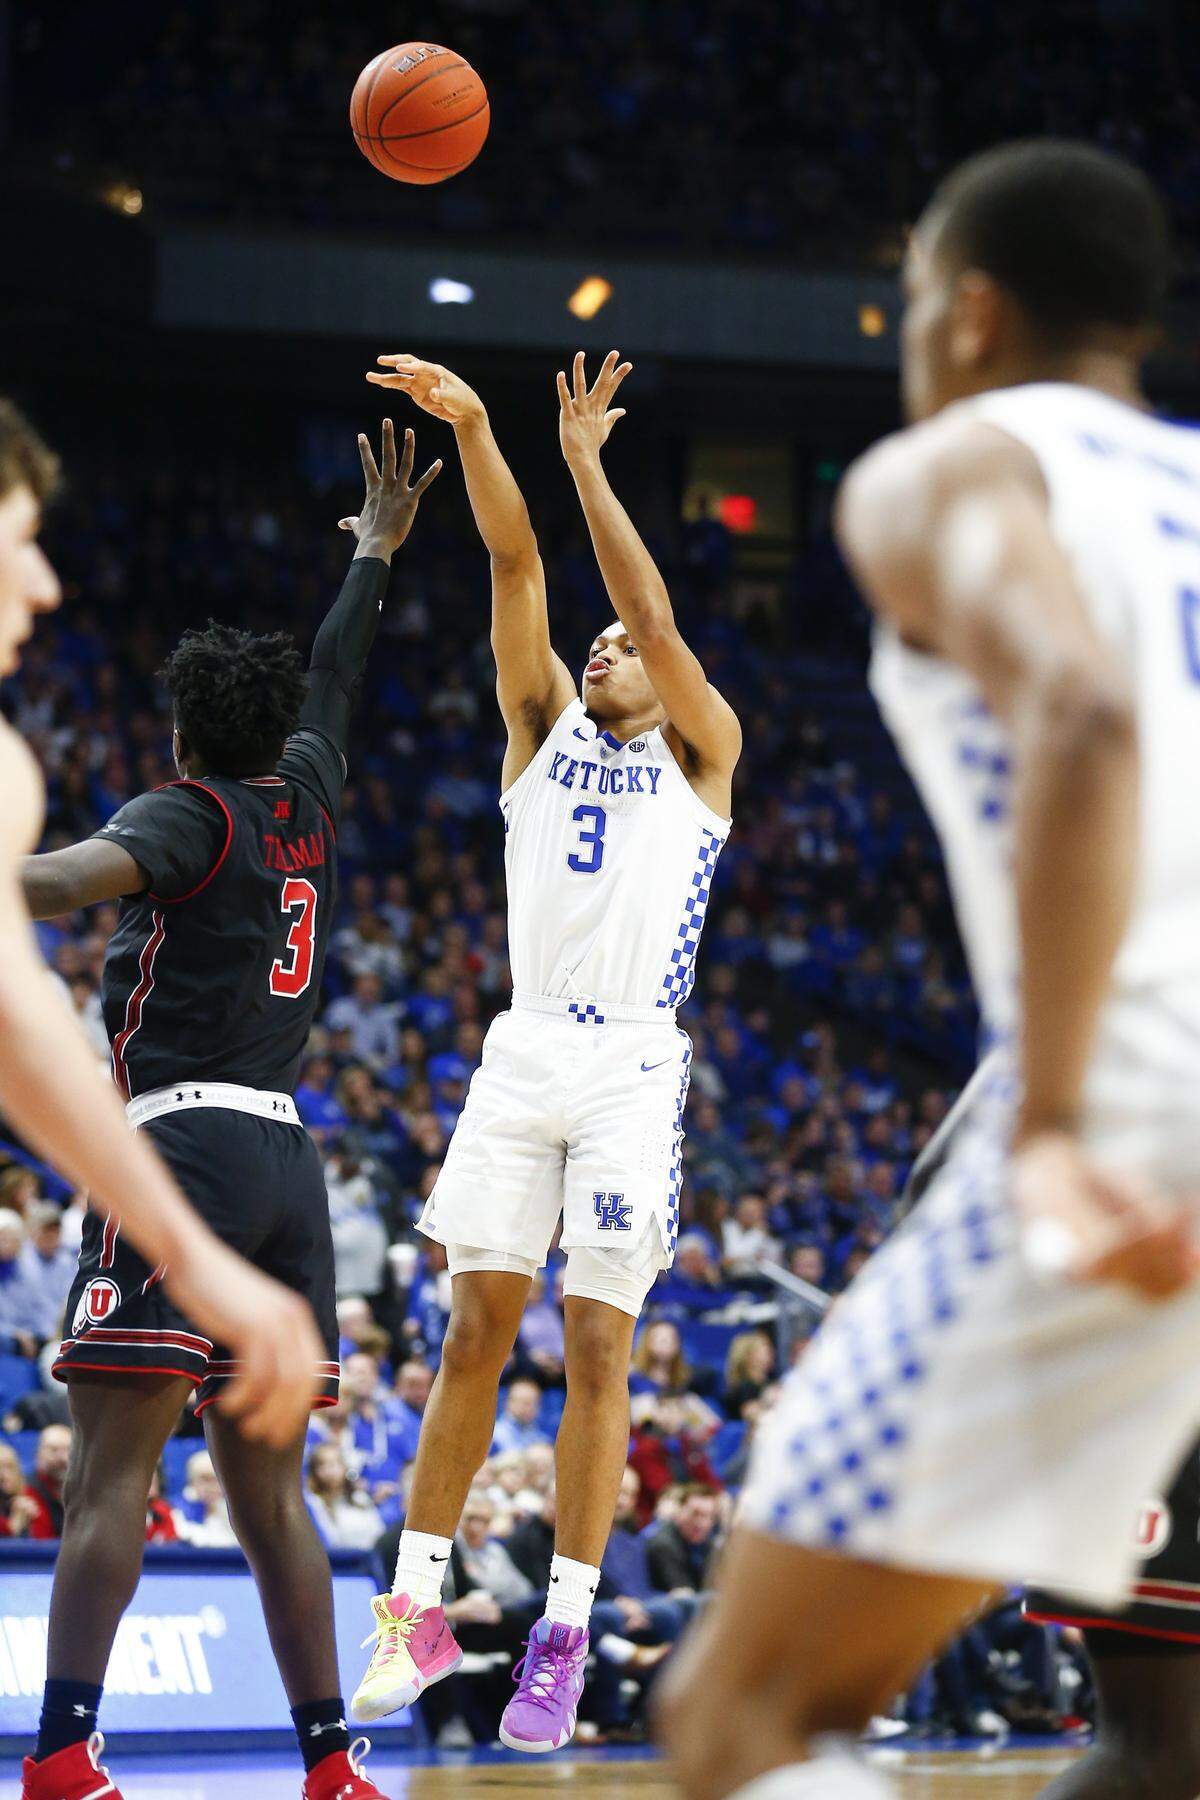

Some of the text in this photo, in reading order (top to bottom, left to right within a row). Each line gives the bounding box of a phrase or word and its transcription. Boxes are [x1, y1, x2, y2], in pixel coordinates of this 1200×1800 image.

[630, 741, 645, 752] SEC
[567, 804, 606, 873] 3
[269, 877, 317, 998] 3
[593, 1192, 633, 1230] UK
[91, 1289, 113, 1317] U
